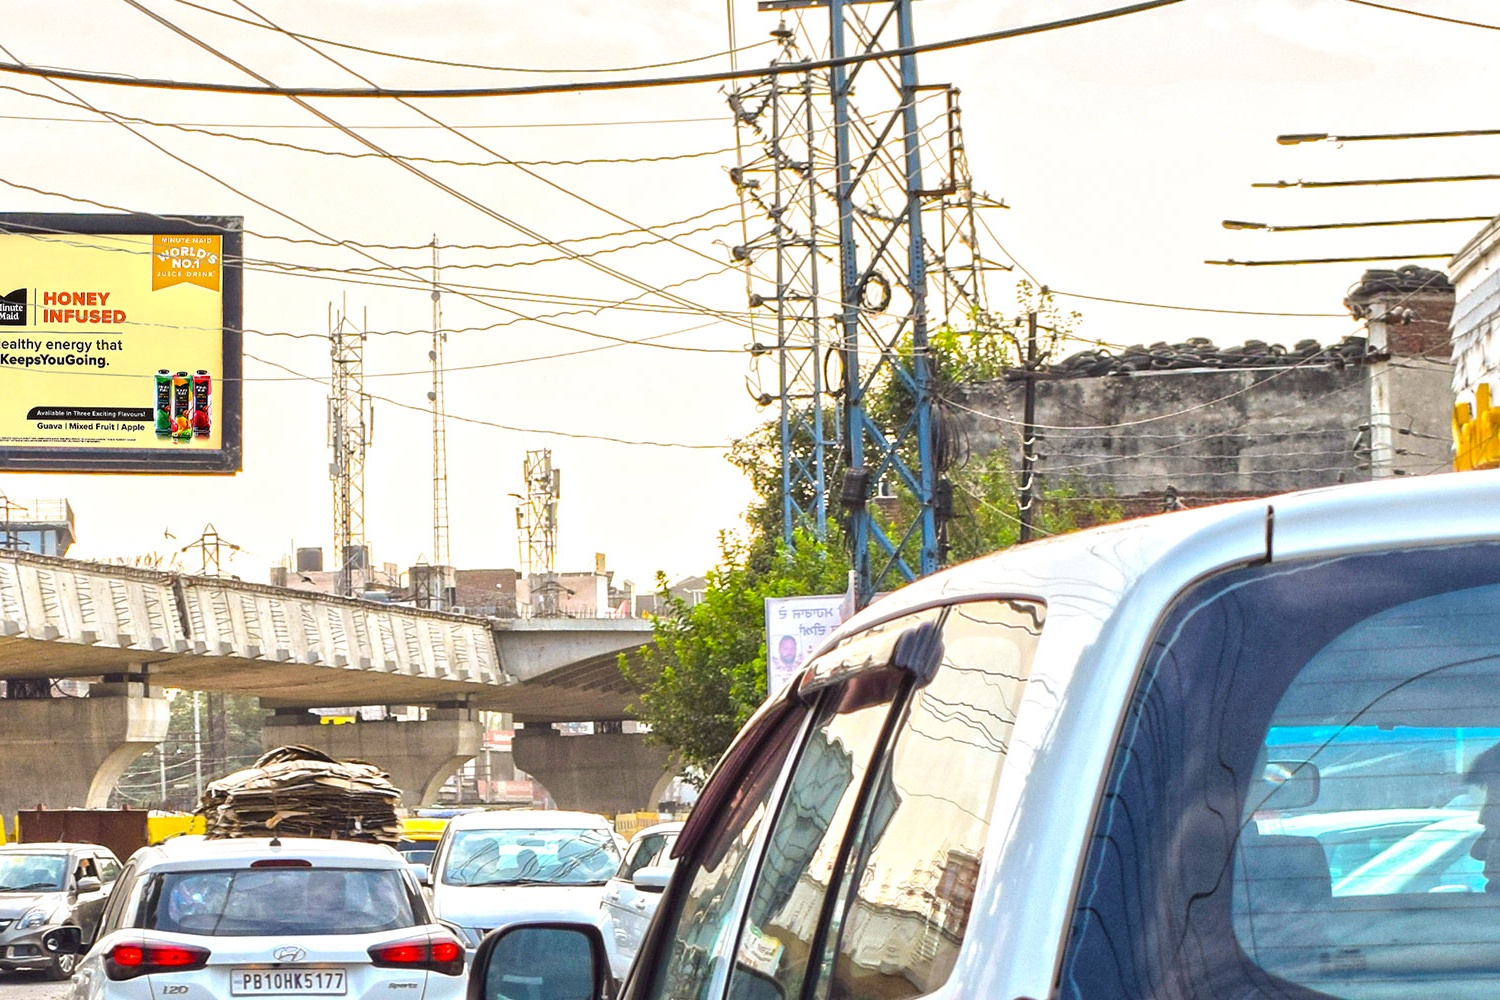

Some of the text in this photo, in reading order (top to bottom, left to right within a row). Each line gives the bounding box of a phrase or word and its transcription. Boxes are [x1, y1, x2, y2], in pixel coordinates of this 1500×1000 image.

[157, 246, 218, 264] WORLD'S
[172, 259, 200, 269] NO.1
[43, 292, 111, 306] HONEY
[43, 309, 127, 324] INFUSED
[46, 340, 92, 353] energy
[96, 339, 123, 351] that
[92, 410, 116, 418] Exciting
[37, 422, 63, 430] Guava
[121, 424, 145, 432] Apple
[242, 973, 344, 990] PB10HK5177
